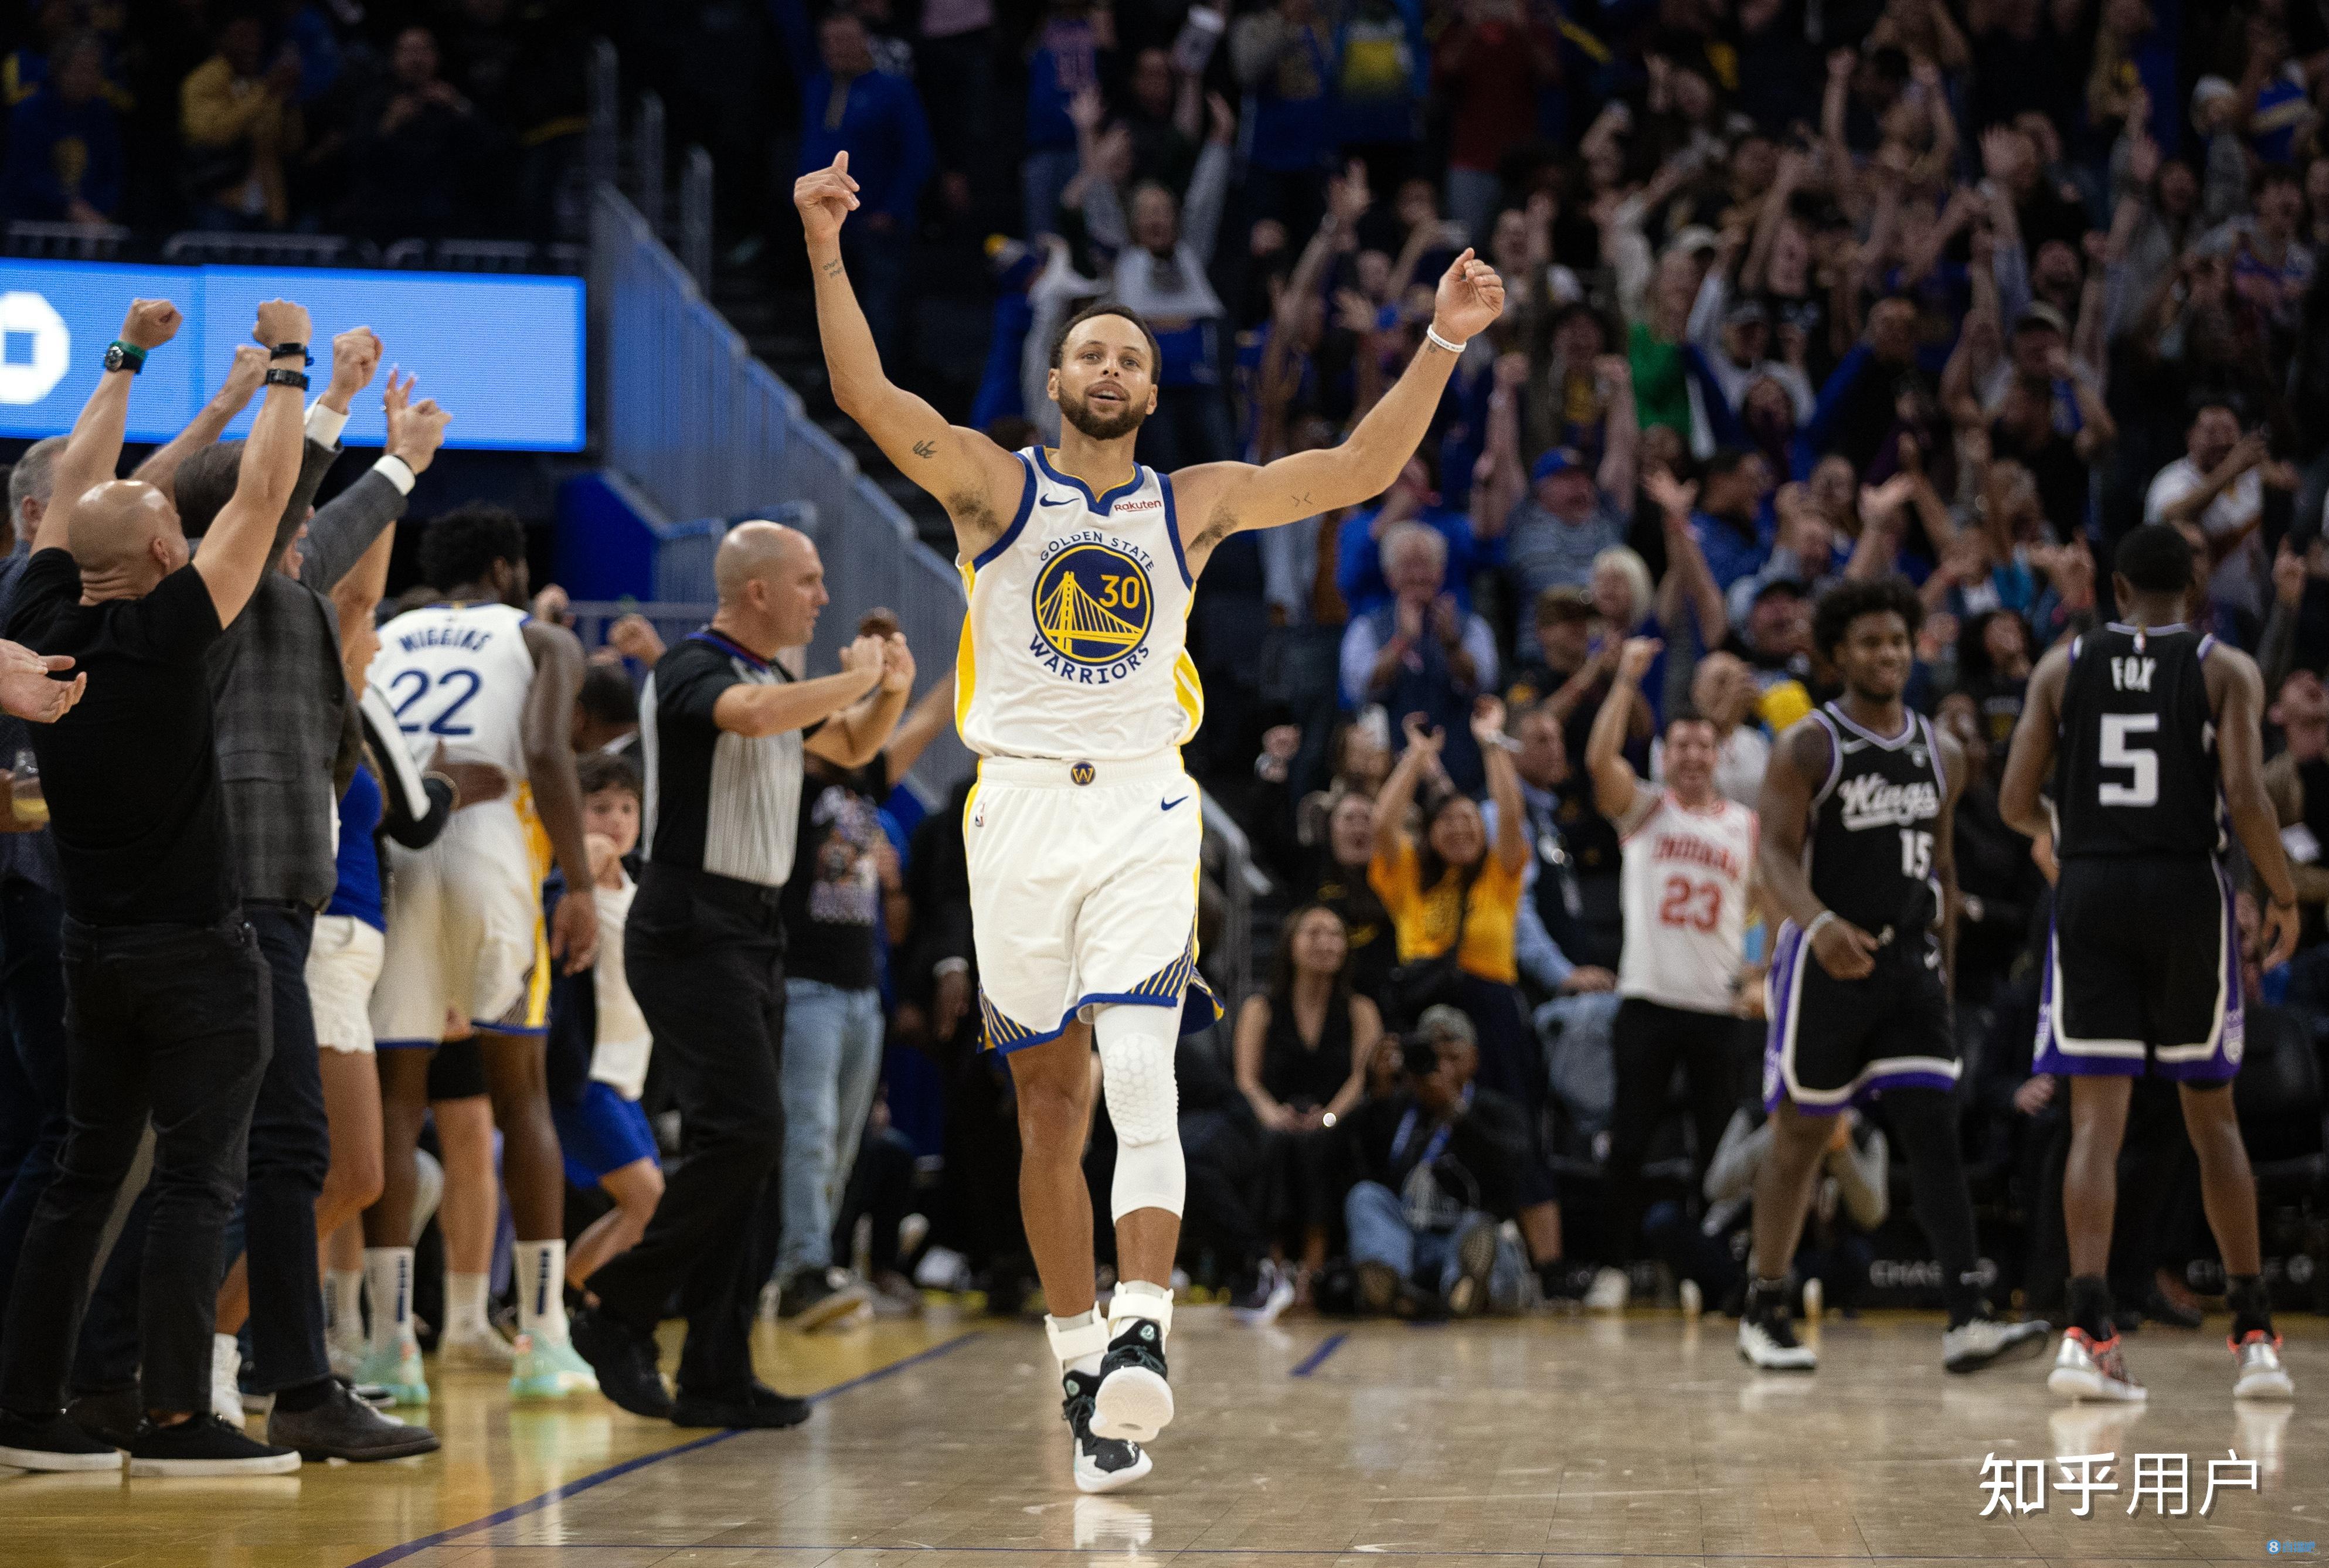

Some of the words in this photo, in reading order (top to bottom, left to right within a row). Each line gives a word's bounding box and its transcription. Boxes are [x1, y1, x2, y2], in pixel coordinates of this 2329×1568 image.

[1114, 499, 1161, 512] Rakuten
[1040, 531, 1103, 562] GOLDEN
[1111, 538, 1155, 572] STATE
[1099, 574, 1140, 608] 30
[1029, 634, 1149, 684] WARRIORS
[2110, 655, 2157, 693] FOX
[390, 668, 482, 736] 22
[1073, 765, 1094, 784] W
[2099, 712, 2160, 808] 5
[1899, 828, 1934, 880] 15
[1659, 875, 1722, 933] 23
